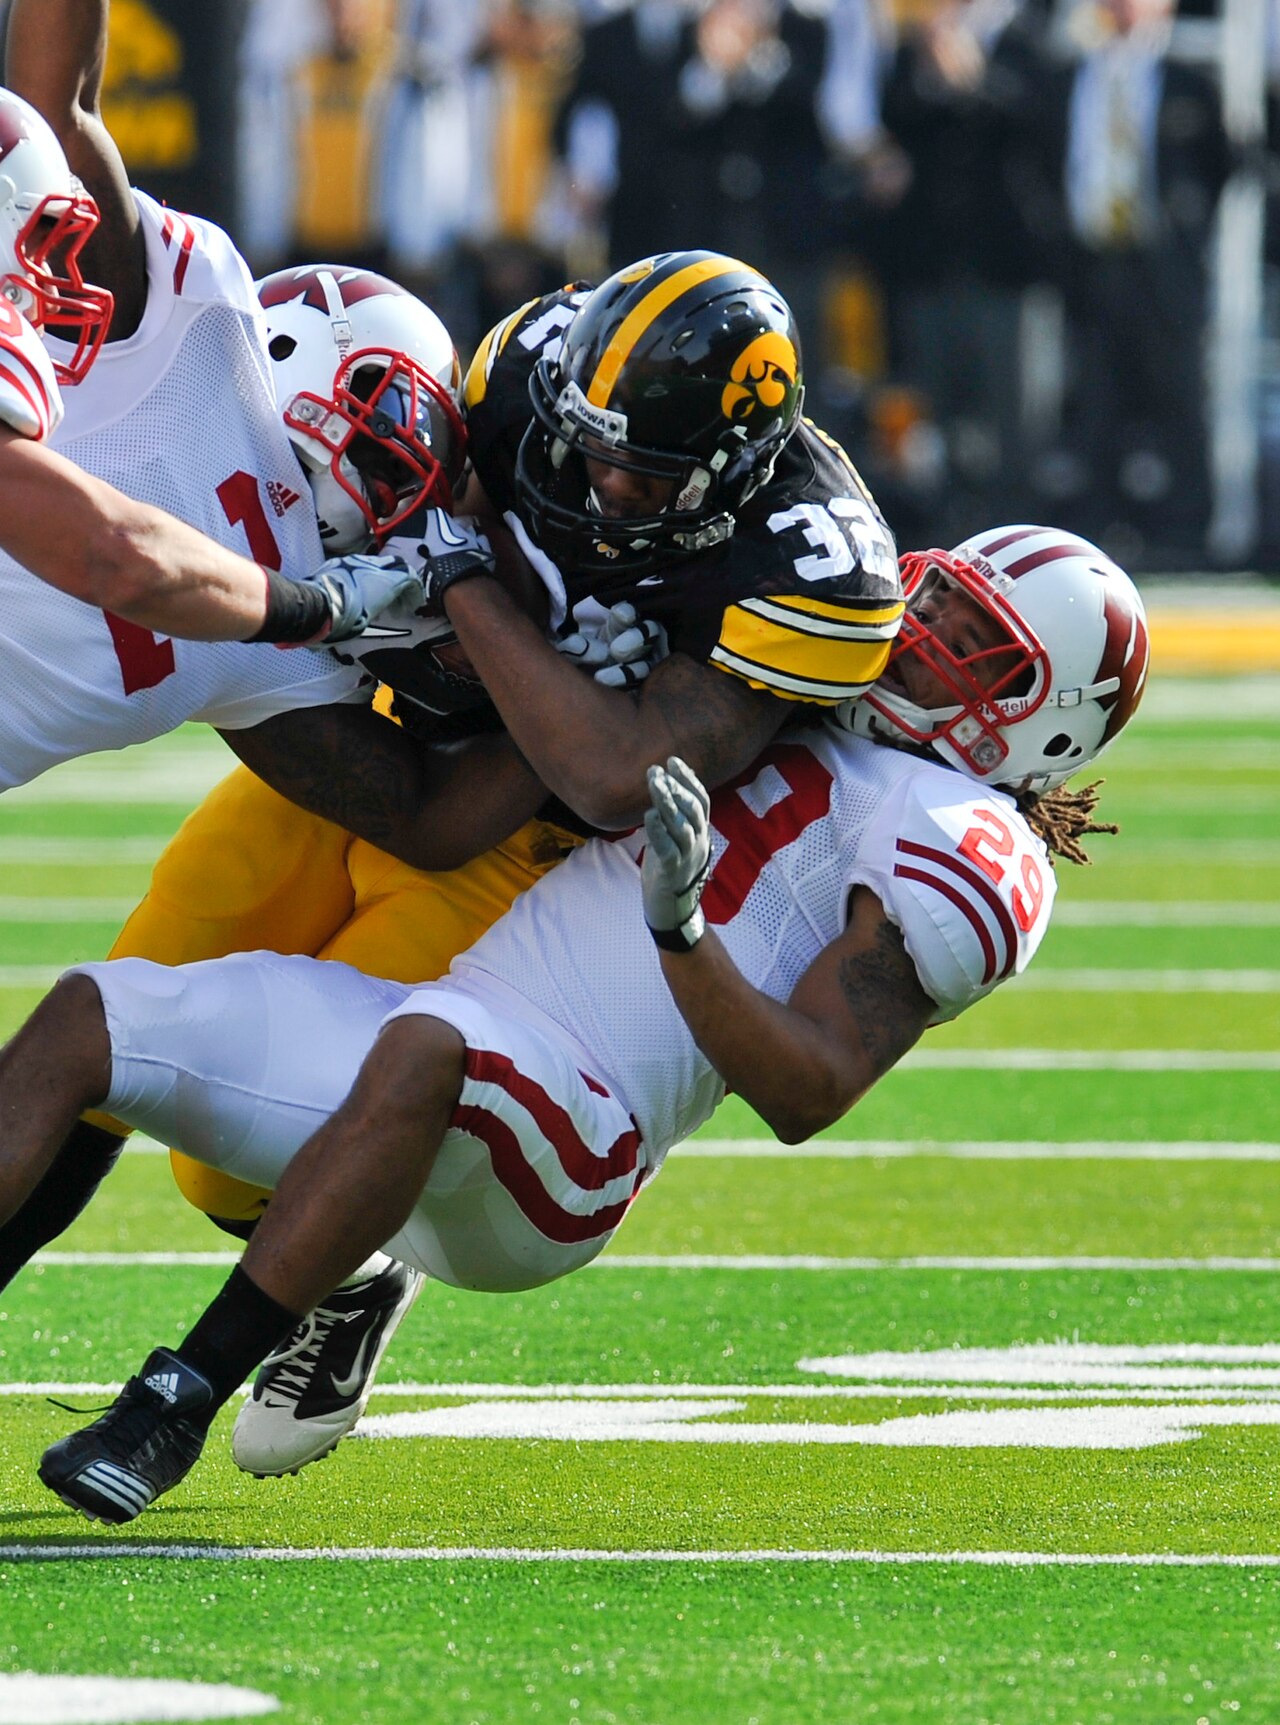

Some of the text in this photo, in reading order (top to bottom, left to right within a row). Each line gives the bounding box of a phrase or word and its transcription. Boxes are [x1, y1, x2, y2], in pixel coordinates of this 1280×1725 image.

[577, 402, 606, 429] IOWA
[265, 480, 285, 517] adidas
[766, 497, 898, 586] 32
[955, 808, 1044, 933] 29
[144, 1377, 178, 1404] adidas
